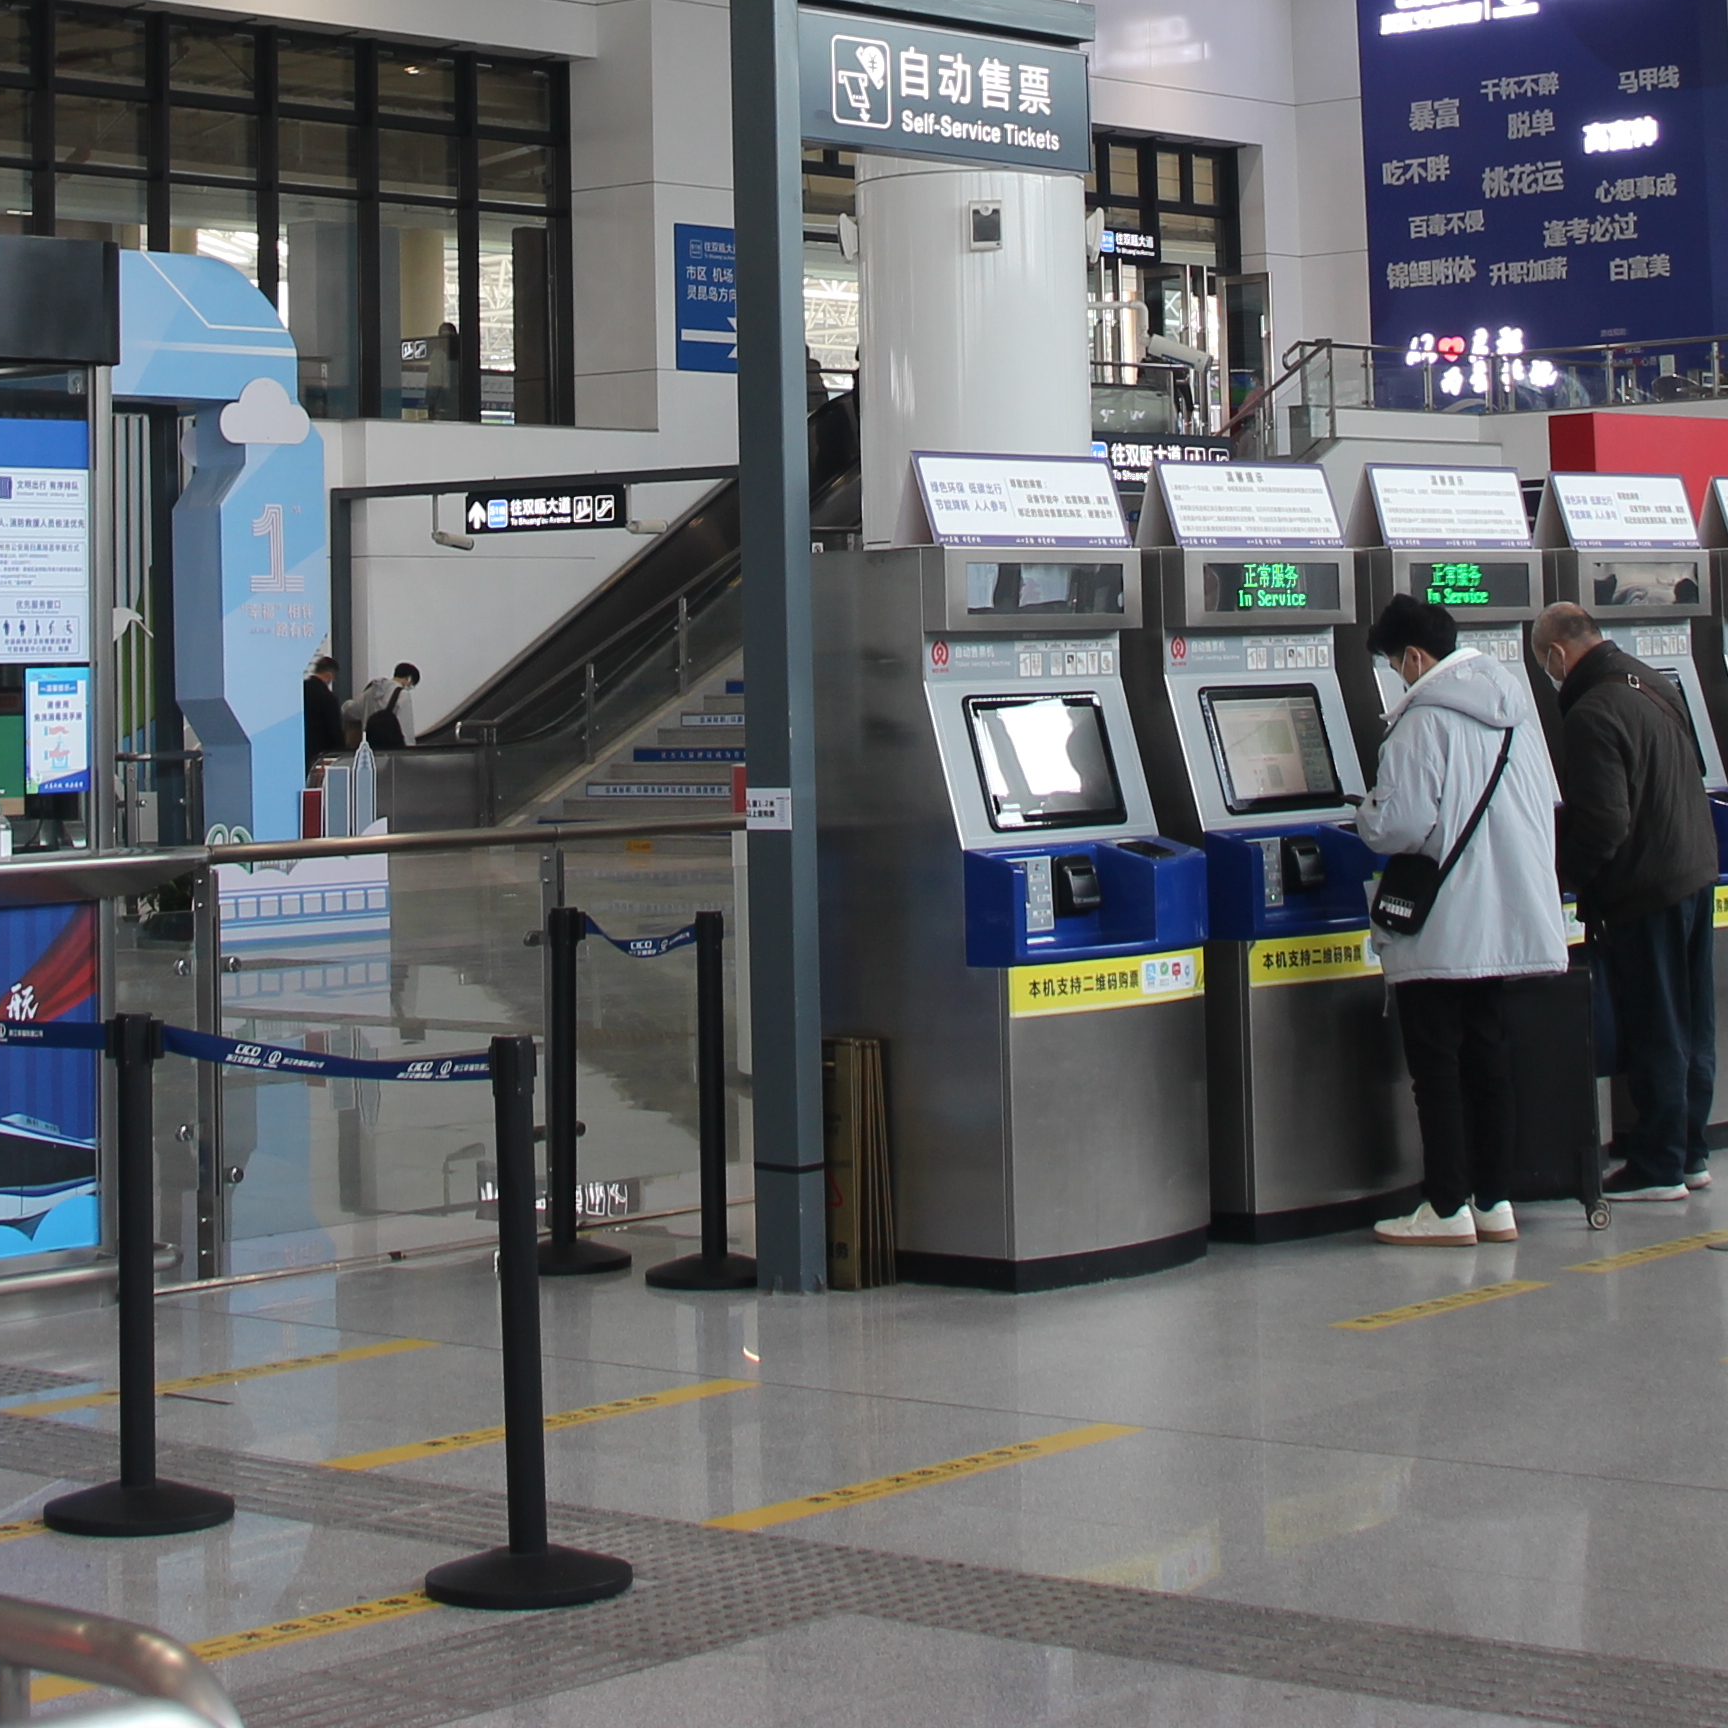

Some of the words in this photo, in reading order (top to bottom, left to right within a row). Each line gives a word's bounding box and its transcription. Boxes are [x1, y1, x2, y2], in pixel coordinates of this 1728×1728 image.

[899, 46, 1052, 116] 自动售票
[1618, 65, 1680, 94] 马甲线
[1409, 97, 1460, 131] 暴富
[1507, 108, 1555, 140] 脱单
[901, 110, 1001, 144] Self-Service
[1004, 122, 1060, 151] Tickets
[1382, 154, 1451, 186] 吃不胖
[1482, 160, 1565, 199] 桃花运
[1595, 173, 1677, 203] 心想事成
[1408, 209, 1485, 239] 百毒不侵
[1543, 212, 1638, 249] 逢考必过
[686, 265, 708, 281] 市区
[712, 267, 733, 284] 机场
[1386, 255, 1477, 290] 锦鲤附体
[1489, 256, 1568, 287] 升职加薪
[1609, 253, 1671, 281] 白富美
[16, 480, 46, 490] 文明出行
[49, 481, 79, 491] 有序排队
[929, 481, 964, 494] 绿色环保
[968, 482, 1003, 495] 低碳出行
[510, 496, 571, 517] 往双瓯大道
[974, 499, 1008, 513] 人人参与
[1243, 563, 1299, 589] 正常服务
[1238, 589, 1253, 607] In
[1259, 588, 1307, 608] Service
[1426, 588, 1441, 604] In
[1444, 587, 1490, 604] Service
[1262, 944, 1362, 970] 本机支持二维码购票
[1028, 970, 1140, 999] 本机支持二维码购票
[234, 1043, 262, 1057] CICO
[407, 1061, 434, 1073] CICO
